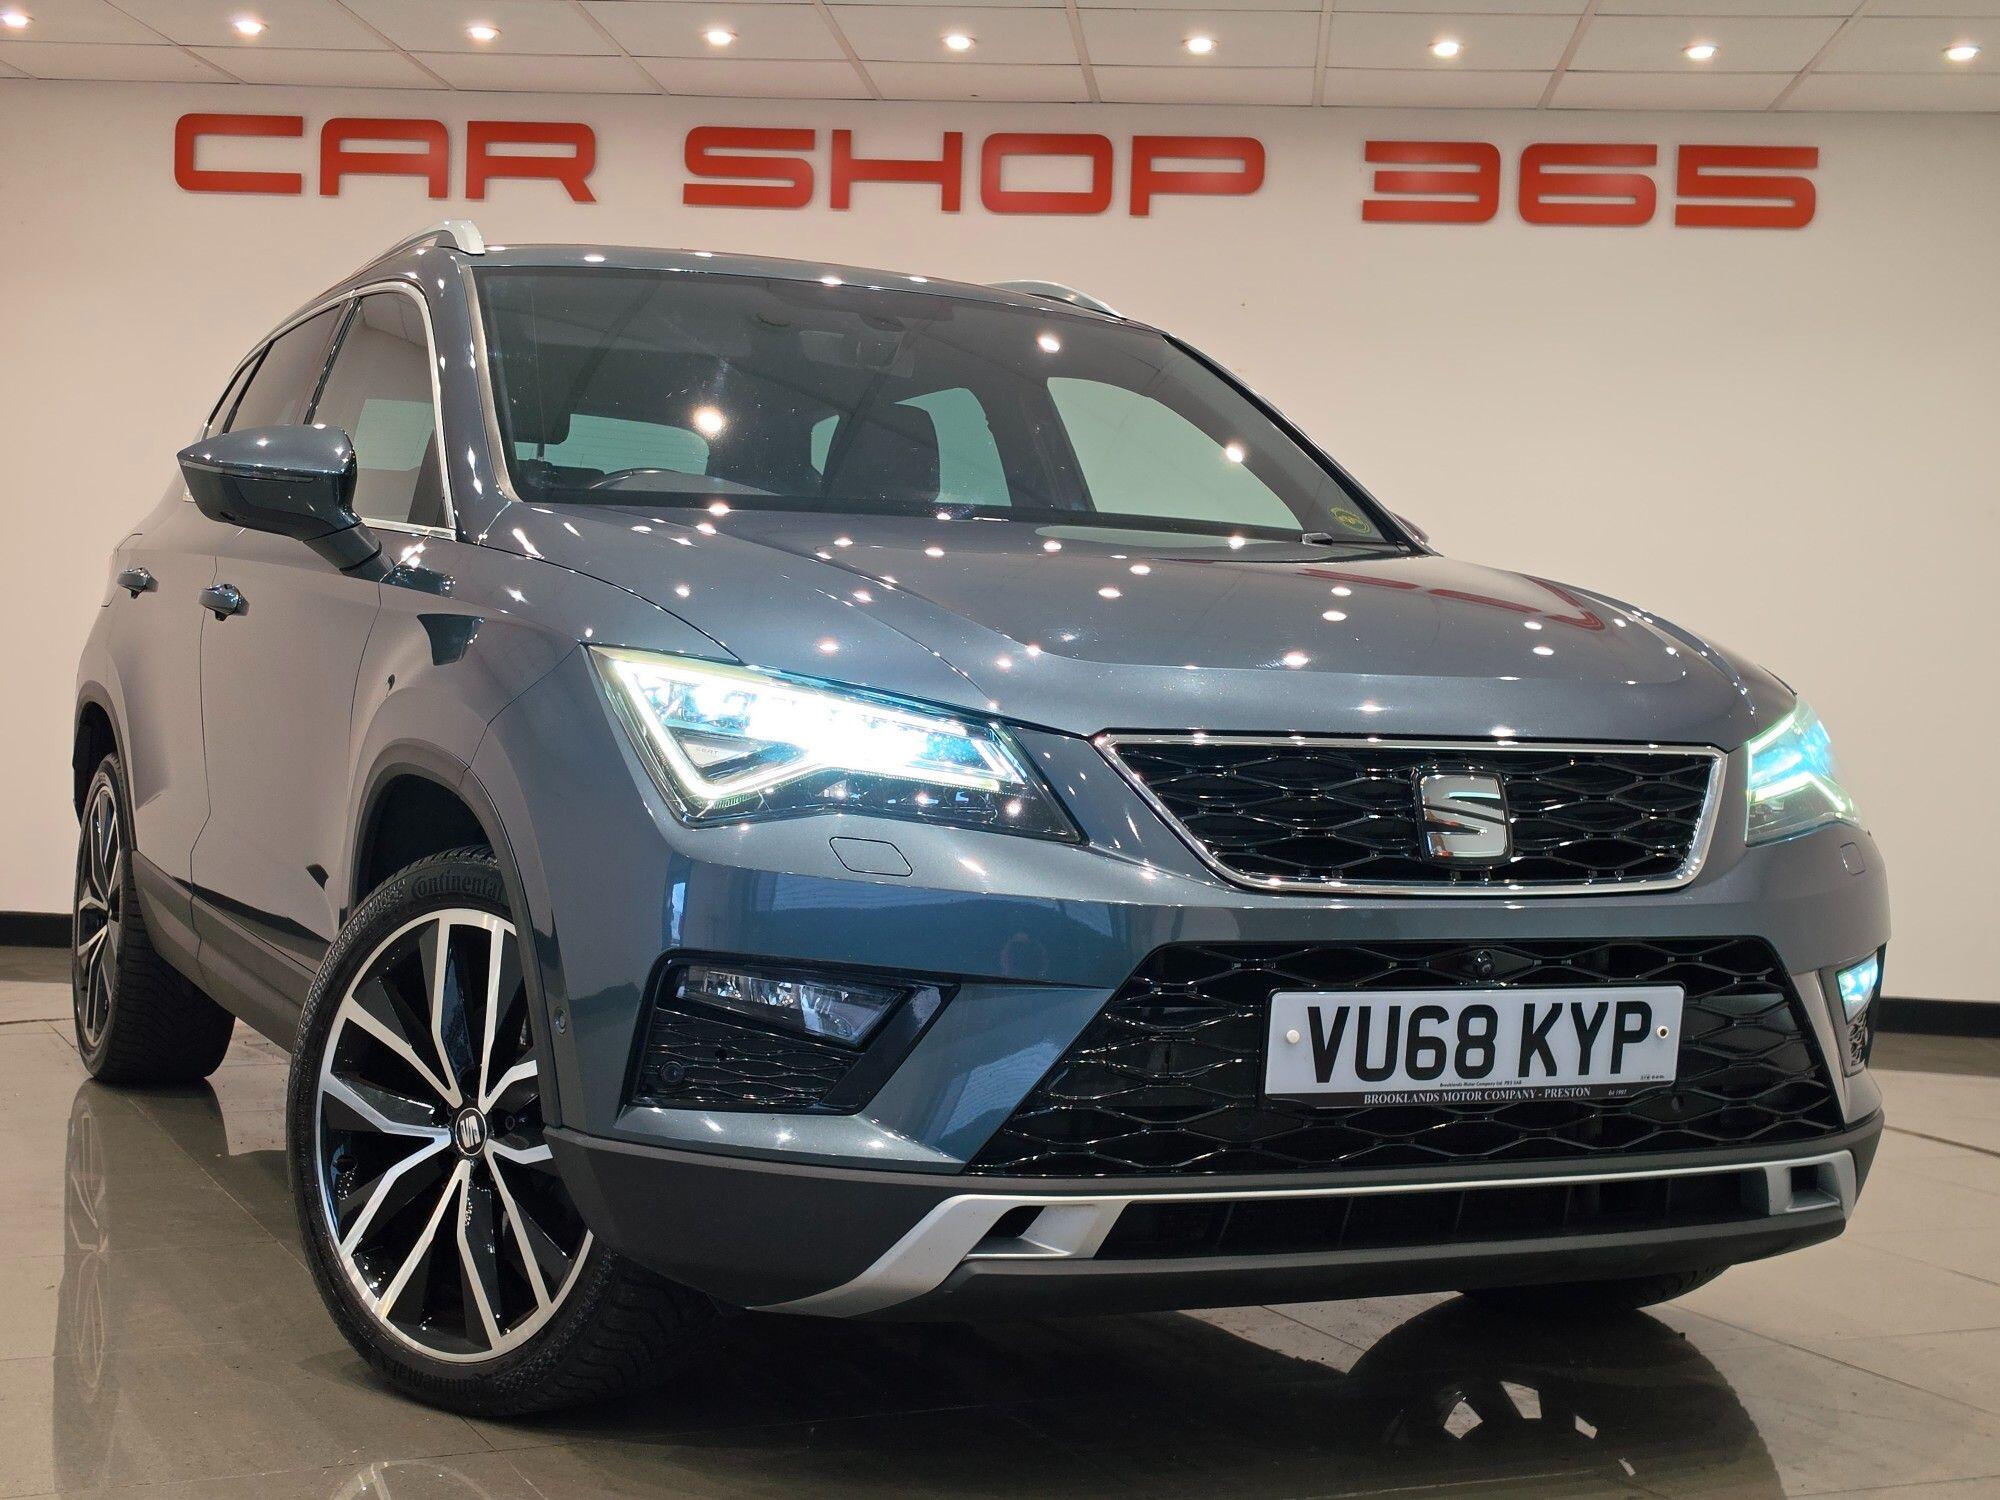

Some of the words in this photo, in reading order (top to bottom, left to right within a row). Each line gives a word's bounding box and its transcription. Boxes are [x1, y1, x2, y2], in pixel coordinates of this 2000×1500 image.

[175, 113, 596, 202] CAR
[683, 126, 1265, 217] SHOP
[1363, 141, 1818, 230] 365
[1307, 1005, 1499, 1083] VU68
[1518, 1001, 1653, 1077] KYP
[1364, 1091, 1440, 1104] BROOKLANDS
[1442, 1090, 1482, 1102] MOTOR
[1484, 1089, 1536, 1101] COMPANY
[1544, 1087, 1591, 1099] PRESTON
